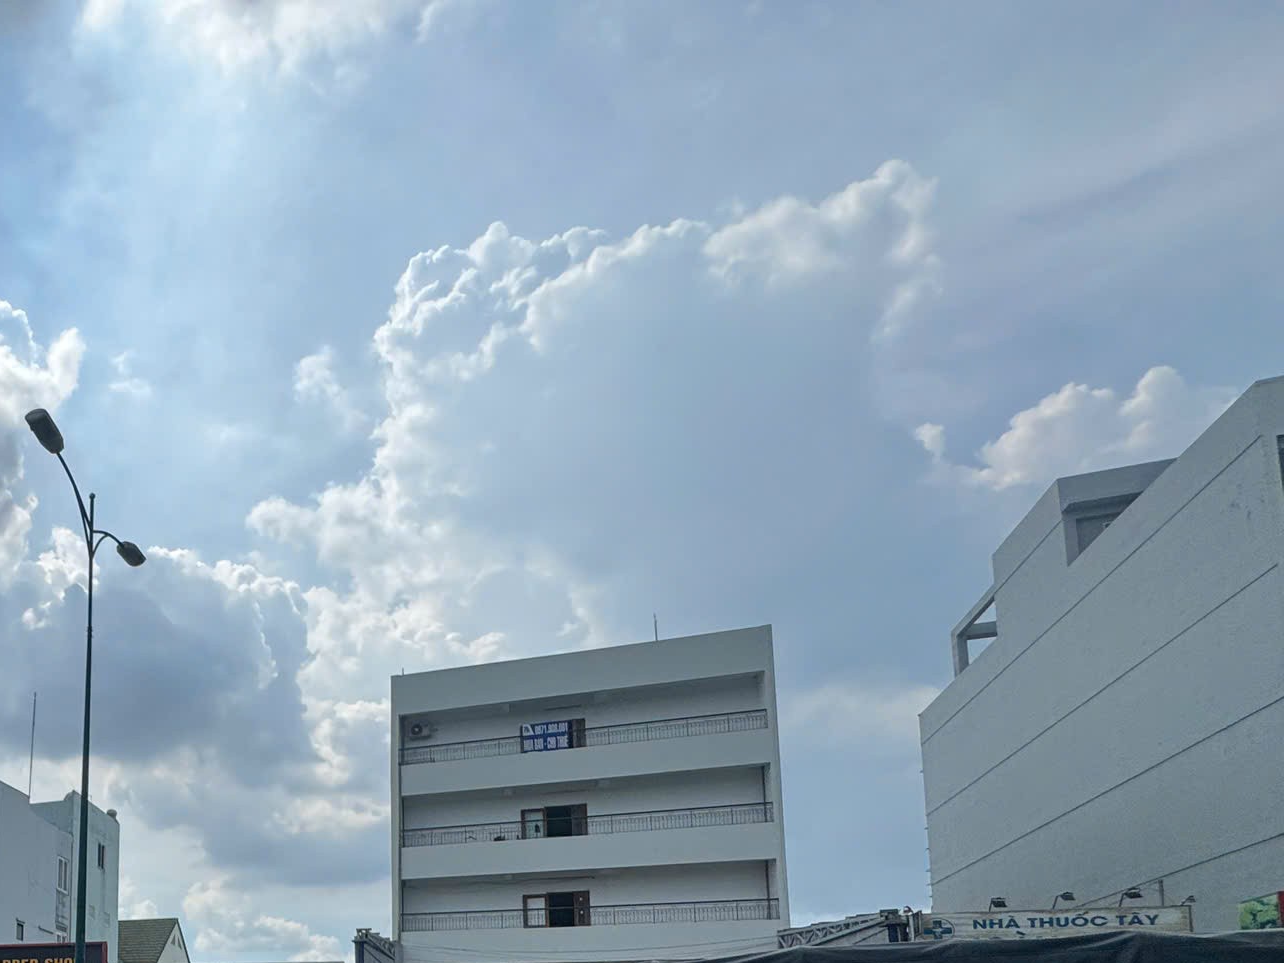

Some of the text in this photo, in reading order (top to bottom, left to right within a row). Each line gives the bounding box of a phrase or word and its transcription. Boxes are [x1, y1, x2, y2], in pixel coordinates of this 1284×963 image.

[972, 911, 1160, 930] NHÀ THUỐC TÂY
